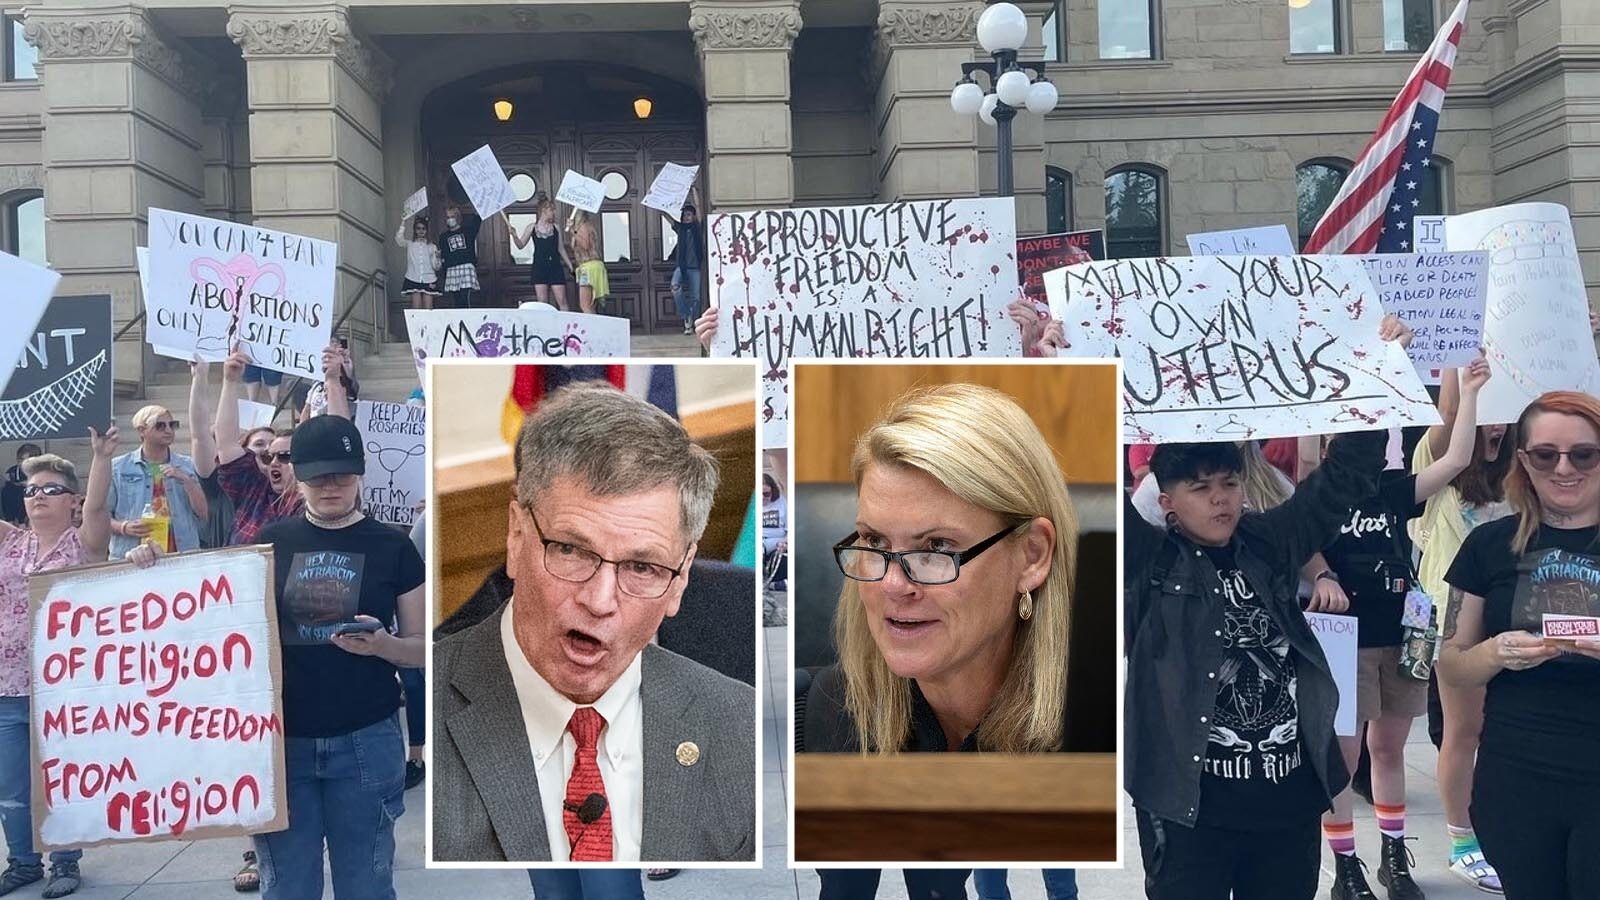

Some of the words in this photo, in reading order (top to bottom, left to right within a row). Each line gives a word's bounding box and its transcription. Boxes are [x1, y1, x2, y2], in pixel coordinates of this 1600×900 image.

[731, 200, 956, 257] REPRODUCTIVE
[1065, 234, 1091, 246] WE
[161, 217, 202, 249] YOU
[283, 238, 323, 267] BAN
[774, 248, 917, 294] FREEDOM
[1416, 255, 1455, 268] ACCESS
[1065, 257, 1182, 303] MIND
[1217, 255, 1350, 300] YOUR
[1379, 273, 1409, 286] LIFE
[1417, 270, 1437, 283] OR
[1441, 270, 1477, 284] DEATH
[814, 289, 837, 308] IS
[862, 285, 877, 303] A
[1379, 288, 1434, 304] ISABLED
[157, 307, 204, 337] ONLY
[247, 322, 292, 346] SAFE
[1150, 300, 1256, 341] OWN
[1397, 309, 1434, 321] RTION
[1440, 308, 1467, 320] LEGAL
[732, 312, 856, 369] HUMAN
[865, 295, 987, 357] RIGHT!
[16, 327, 87, 369] NT
[1408, 341, 1429, 350] WILL
[1434, 340, 1445, 350] BE
[271, 347, 317, 374] ONES
[1114, 337, 1350, 405] UTERUS
[371, 401, 401, 422] KEEP
[406, 406, 425, 423] YOU
[368, 419, 425, 436] ROSARIES
[389, 489, 410, 505] MY
[330, 554, 351, 567] THE
[1309, 617, 1354, 635] RTION
[1573, 621, 1596, 630] YOUR
[43, 647, 87, 685] OF
[43, 702, 150, 741] MEANS
[1204, 754, 1252, 780] ccult
